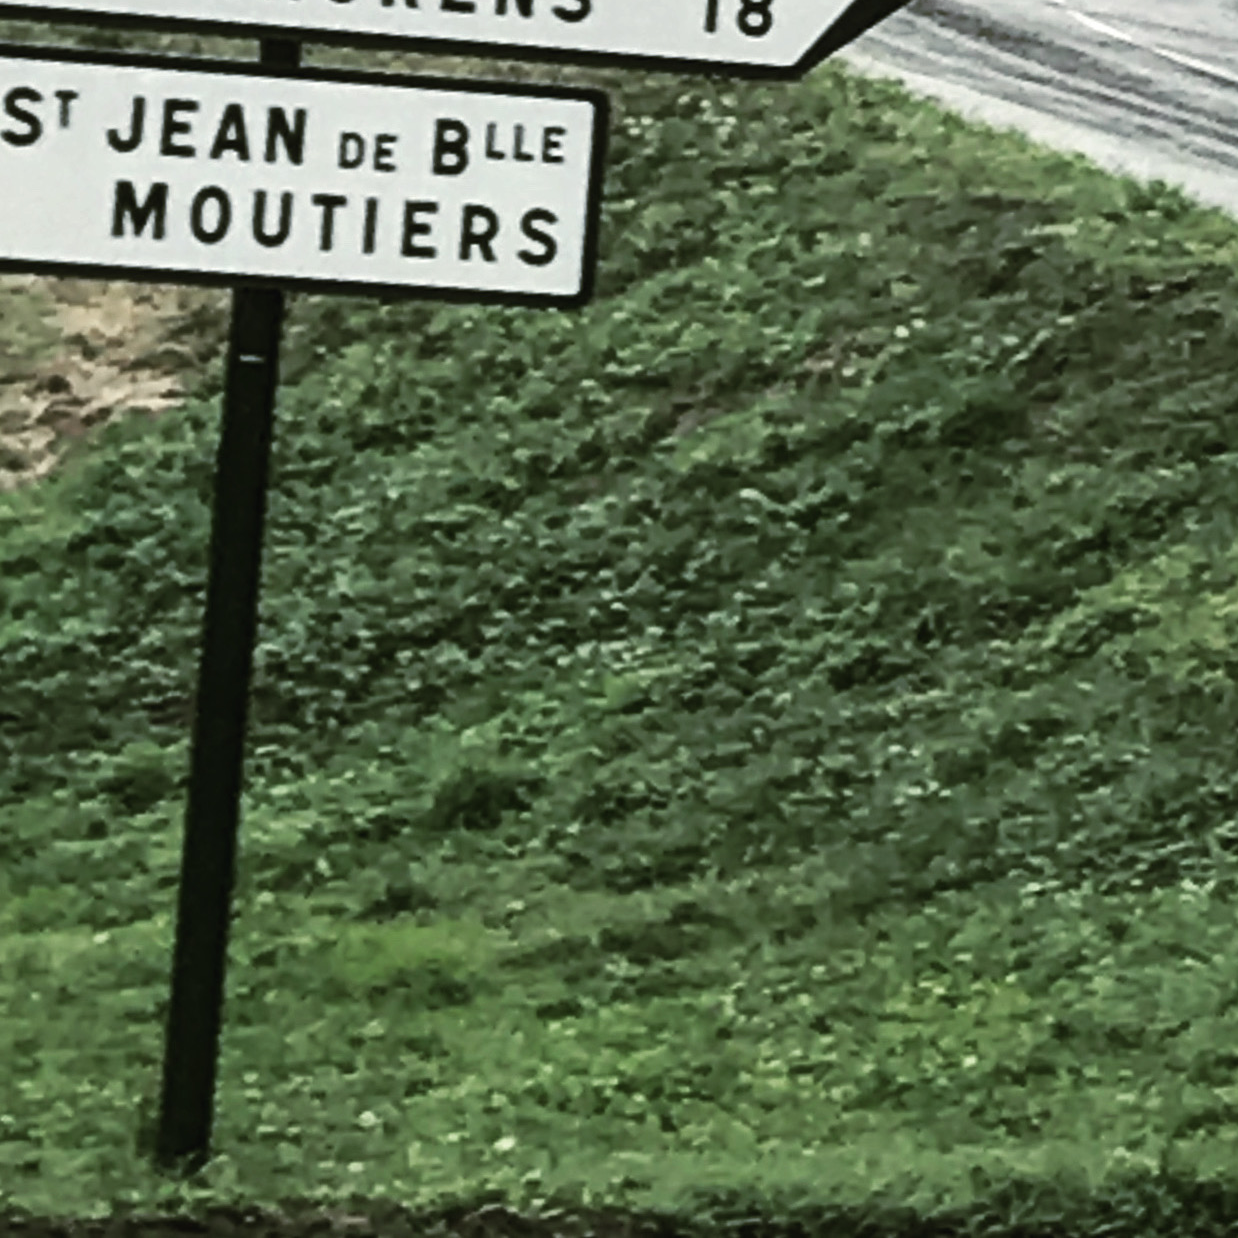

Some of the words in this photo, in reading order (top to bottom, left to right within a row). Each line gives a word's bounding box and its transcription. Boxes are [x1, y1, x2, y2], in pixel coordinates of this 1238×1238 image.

[107, 96, 308, 166] JEAN
[338, 132, 398, 173] DE
[432, 118, 567, 176] BLLE
[111, 180, 559, 267] MOUTIERS
